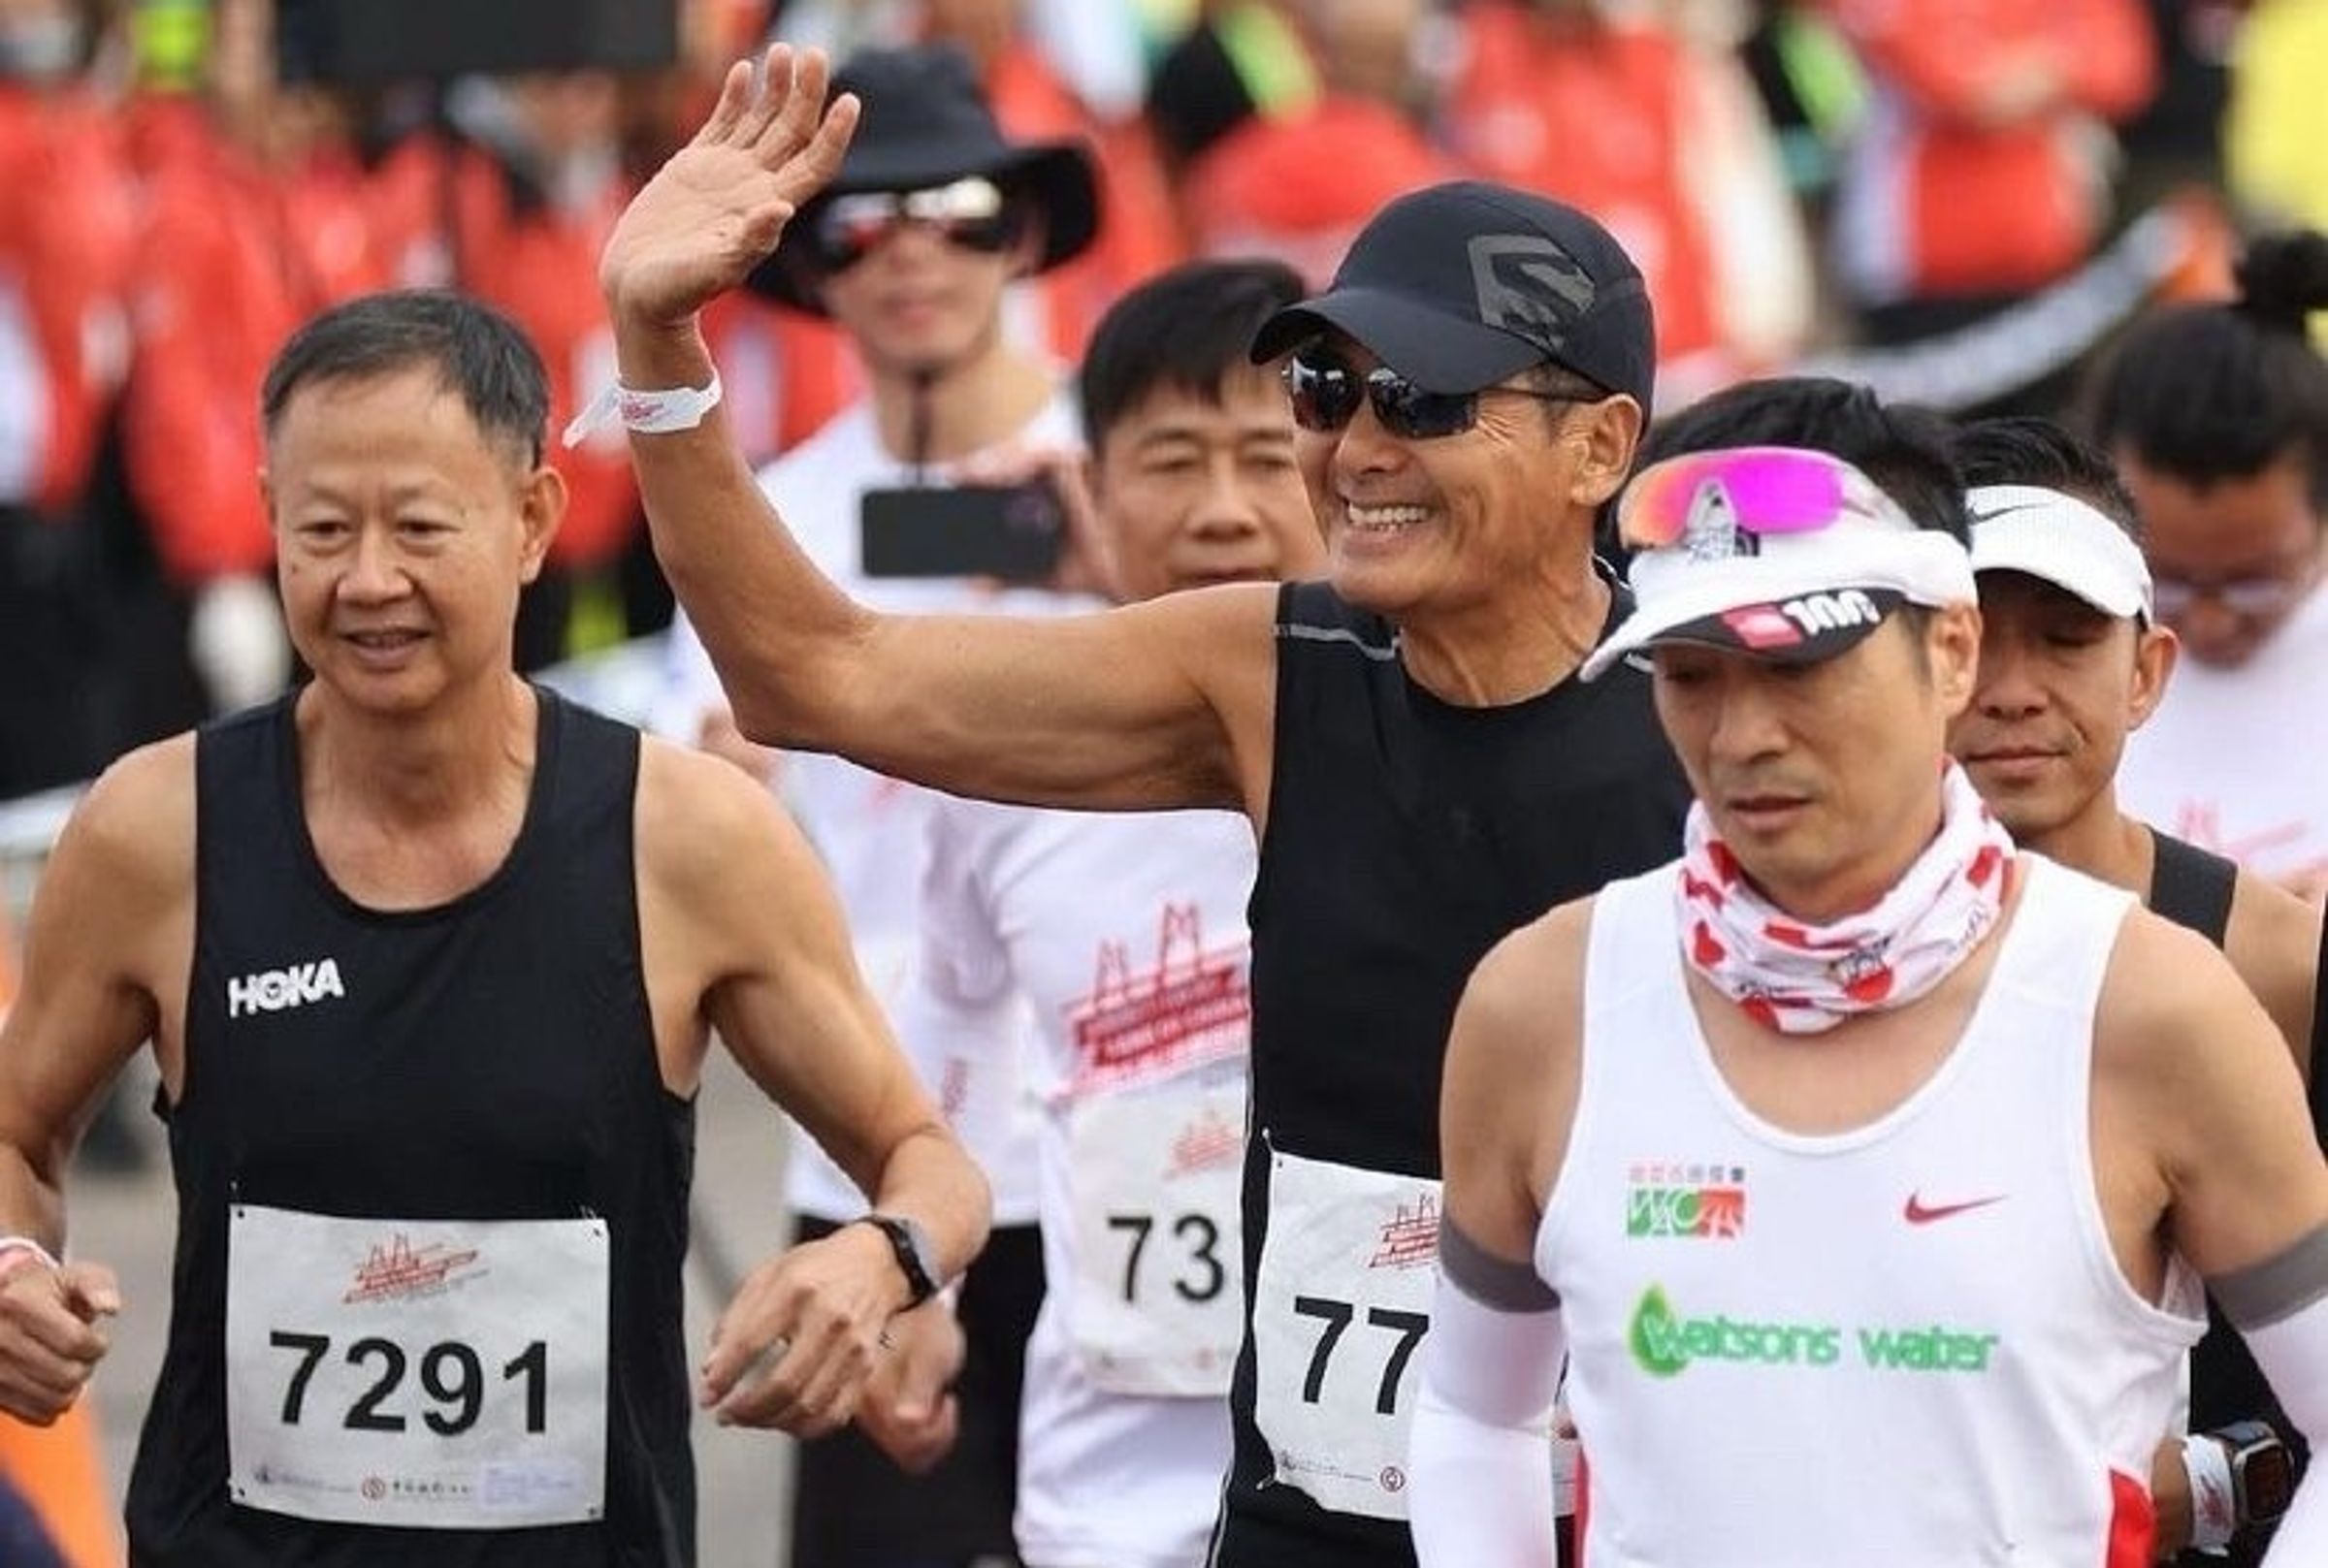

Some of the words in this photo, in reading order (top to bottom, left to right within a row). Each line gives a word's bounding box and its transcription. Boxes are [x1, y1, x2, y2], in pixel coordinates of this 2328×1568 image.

[228, 957, 345, 1018] HOKA
[270, 1330, 547, 1436] 7291
[1294, 1296, 1430, 1415] 77
[1857, 1325, 2000, 1371] water
